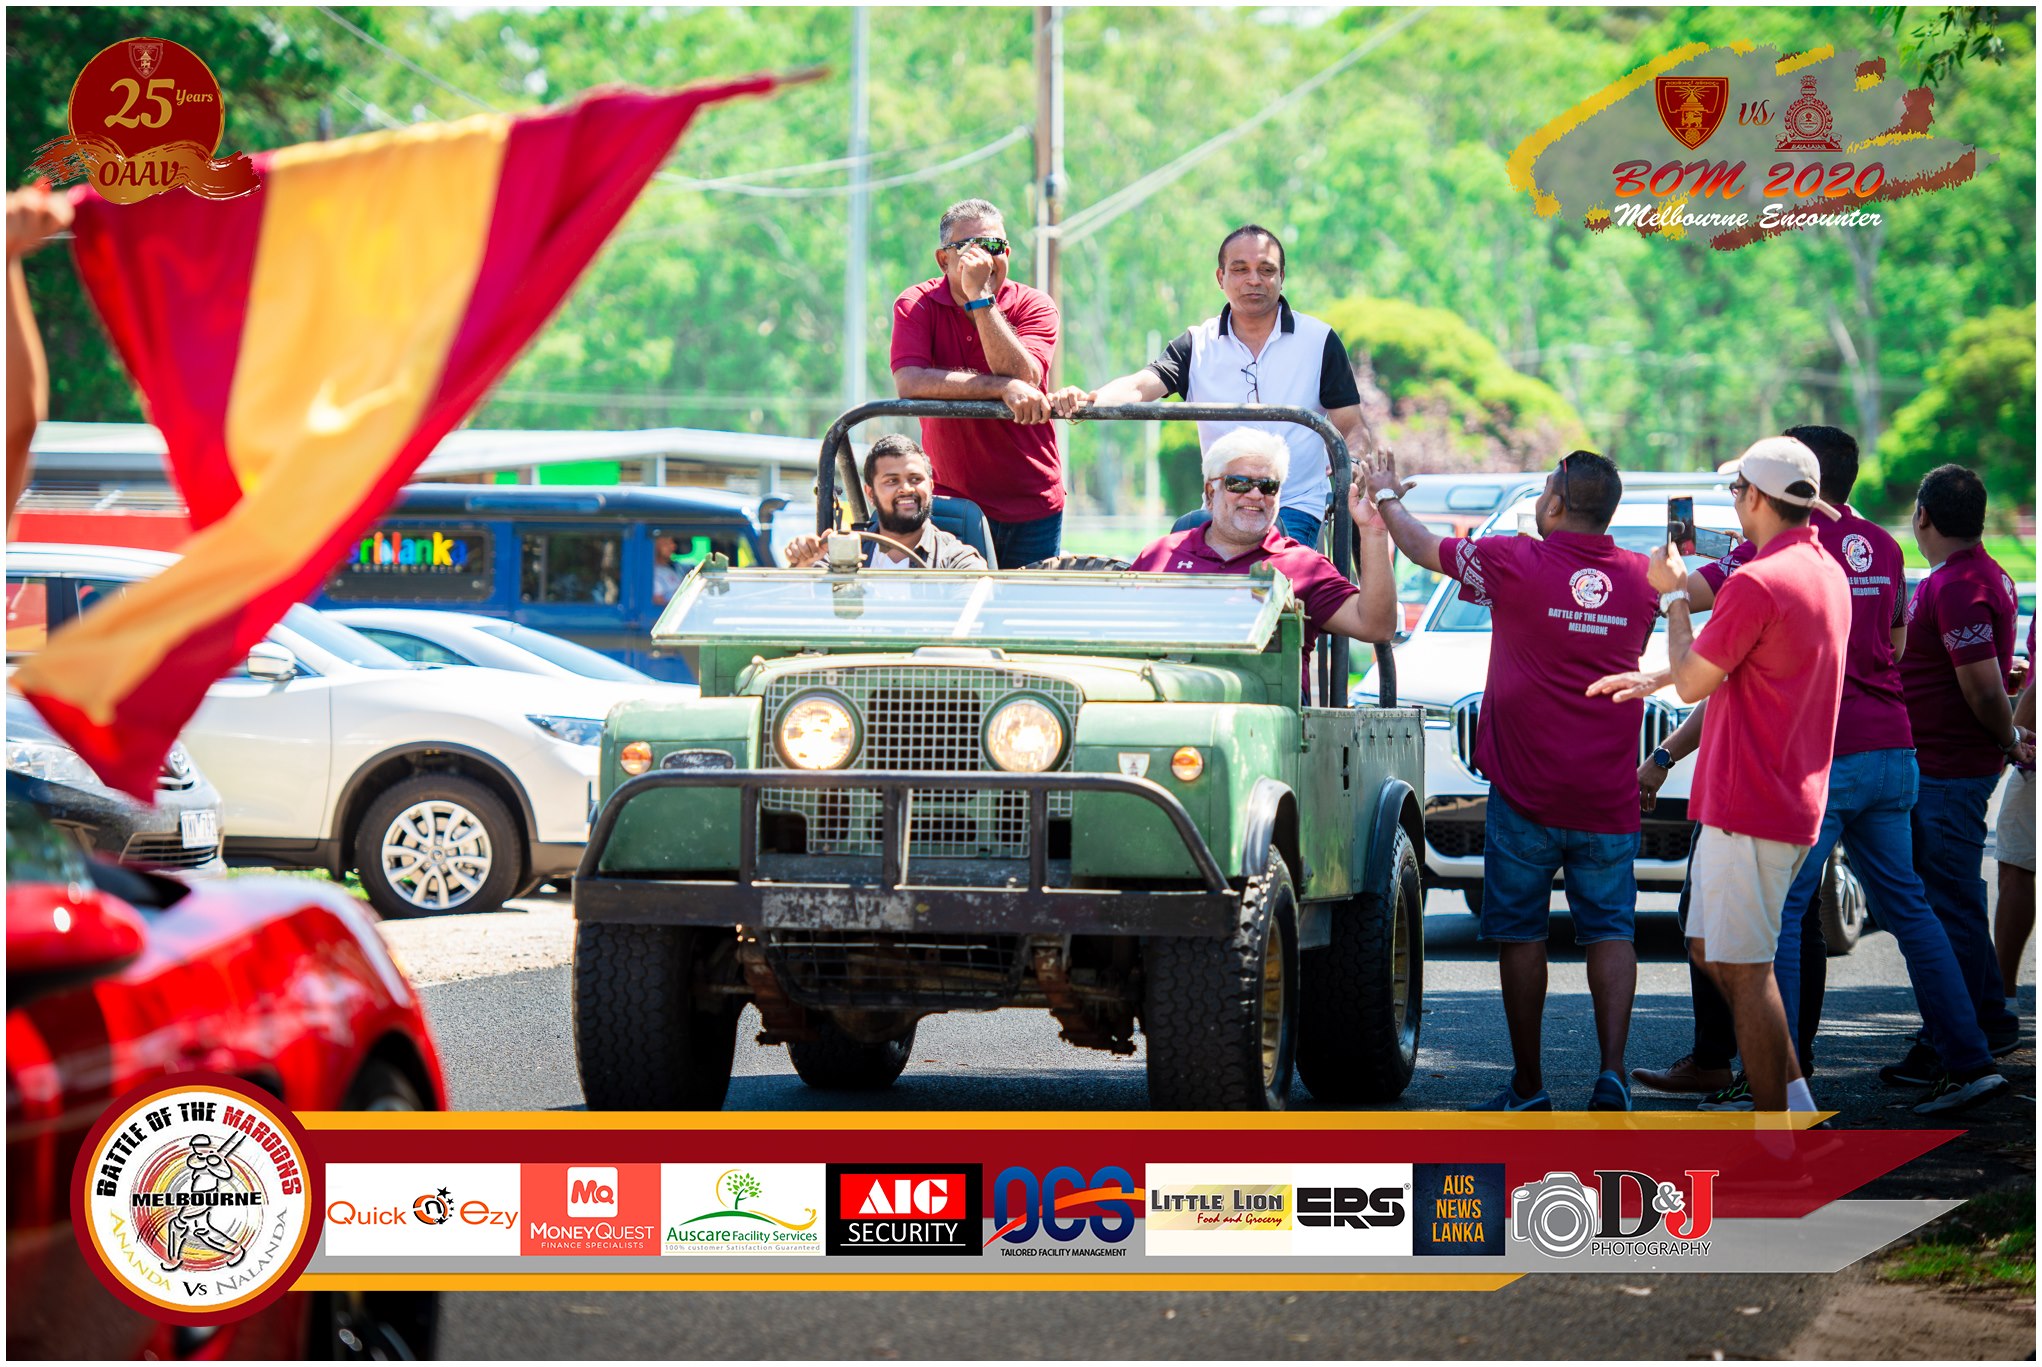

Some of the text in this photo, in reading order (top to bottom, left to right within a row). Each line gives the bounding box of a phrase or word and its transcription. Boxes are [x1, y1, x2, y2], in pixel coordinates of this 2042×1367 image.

[1548, 607, 1628, 627] BATTLE OF THE MAROONS
[1568, 622, 1608, 635] MELBOURNE
